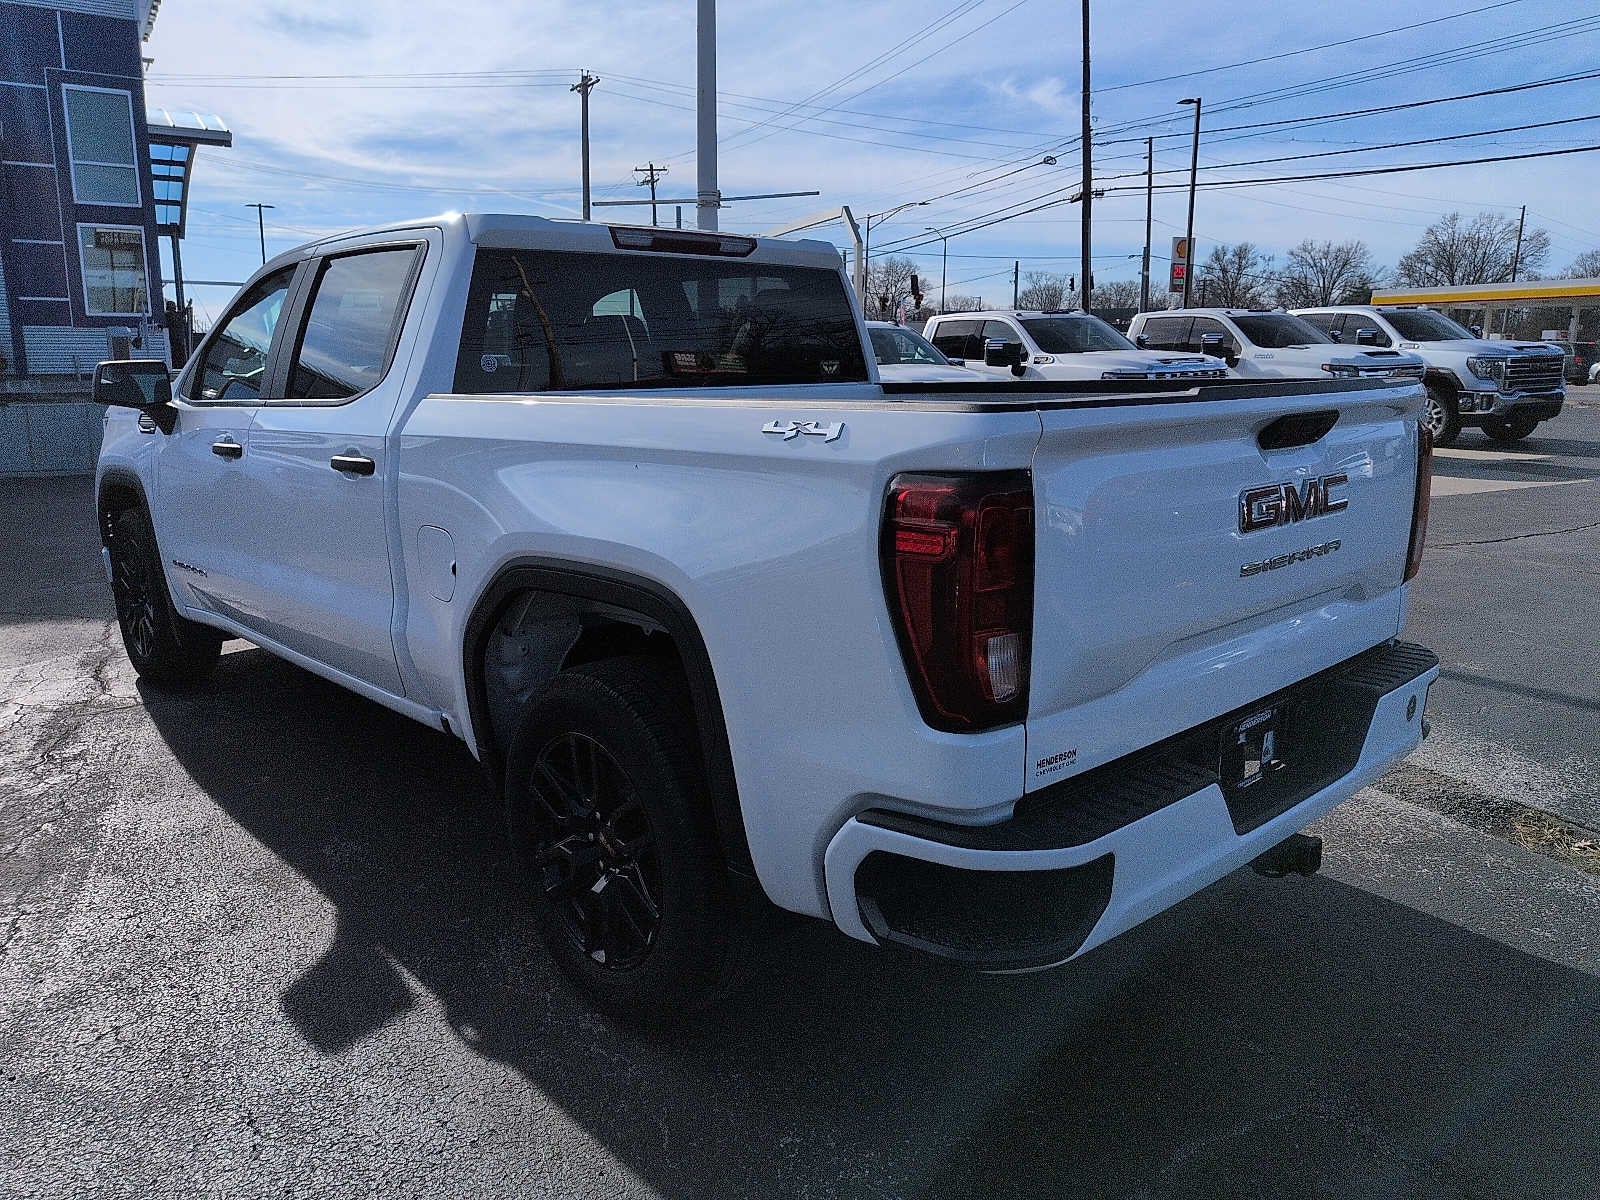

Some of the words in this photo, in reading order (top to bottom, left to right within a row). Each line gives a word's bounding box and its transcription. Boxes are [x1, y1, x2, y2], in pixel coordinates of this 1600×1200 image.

[1239, 473, 1349, 534] GMC
[1239, 539, 1342, 577] SIERRA
[1036, 748, 1078, 769] HENDERSON
